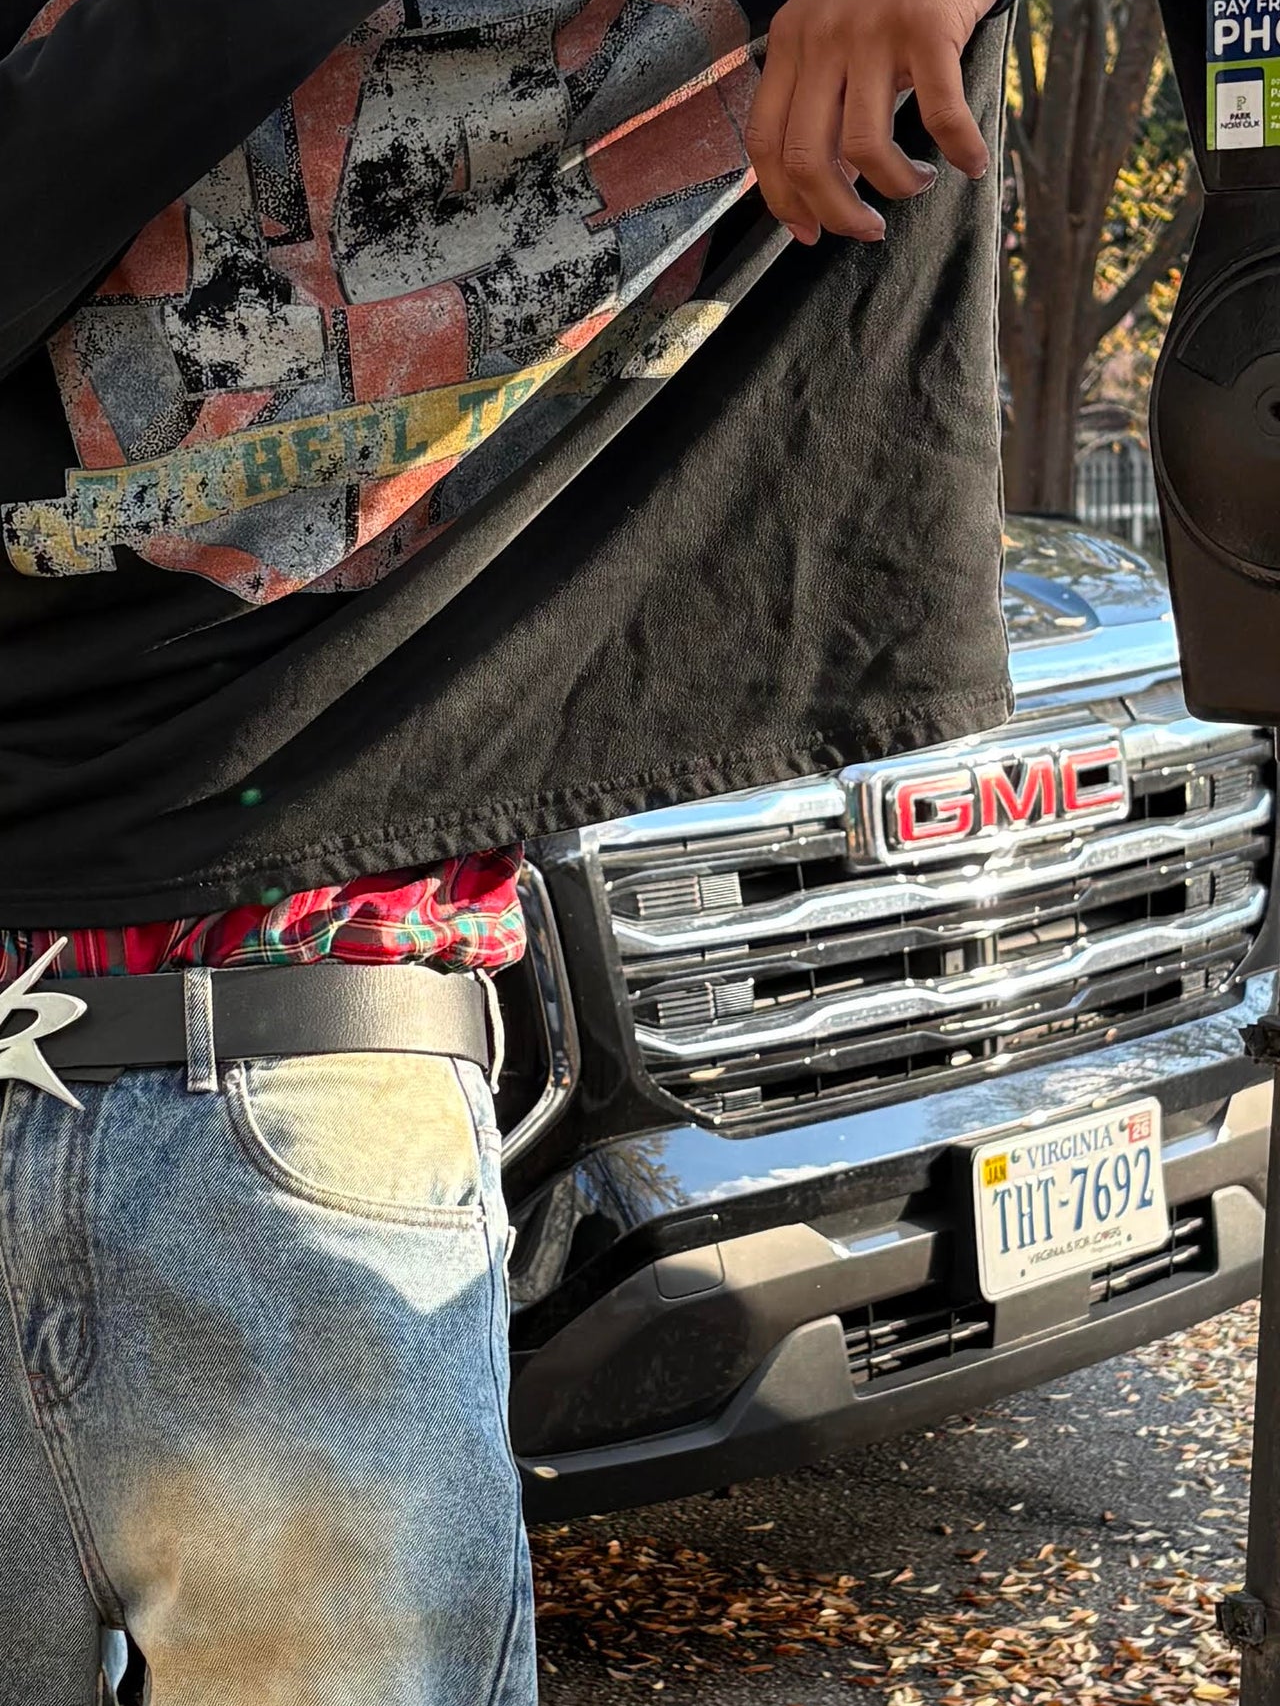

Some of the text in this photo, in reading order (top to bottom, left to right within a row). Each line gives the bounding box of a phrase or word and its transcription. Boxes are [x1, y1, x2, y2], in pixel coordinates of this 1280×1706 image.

[1230, 112, 1251, 120] PARK
[896, 744, 1125, 844] GMC
[1026, 1124, 1114, 1170] VIRGINIA
[1132, 1122, 1150, 1141] 26
[986, 1162, 1007, 1185] JAN
[992, 1145, 1155, 1255] THT-7692
